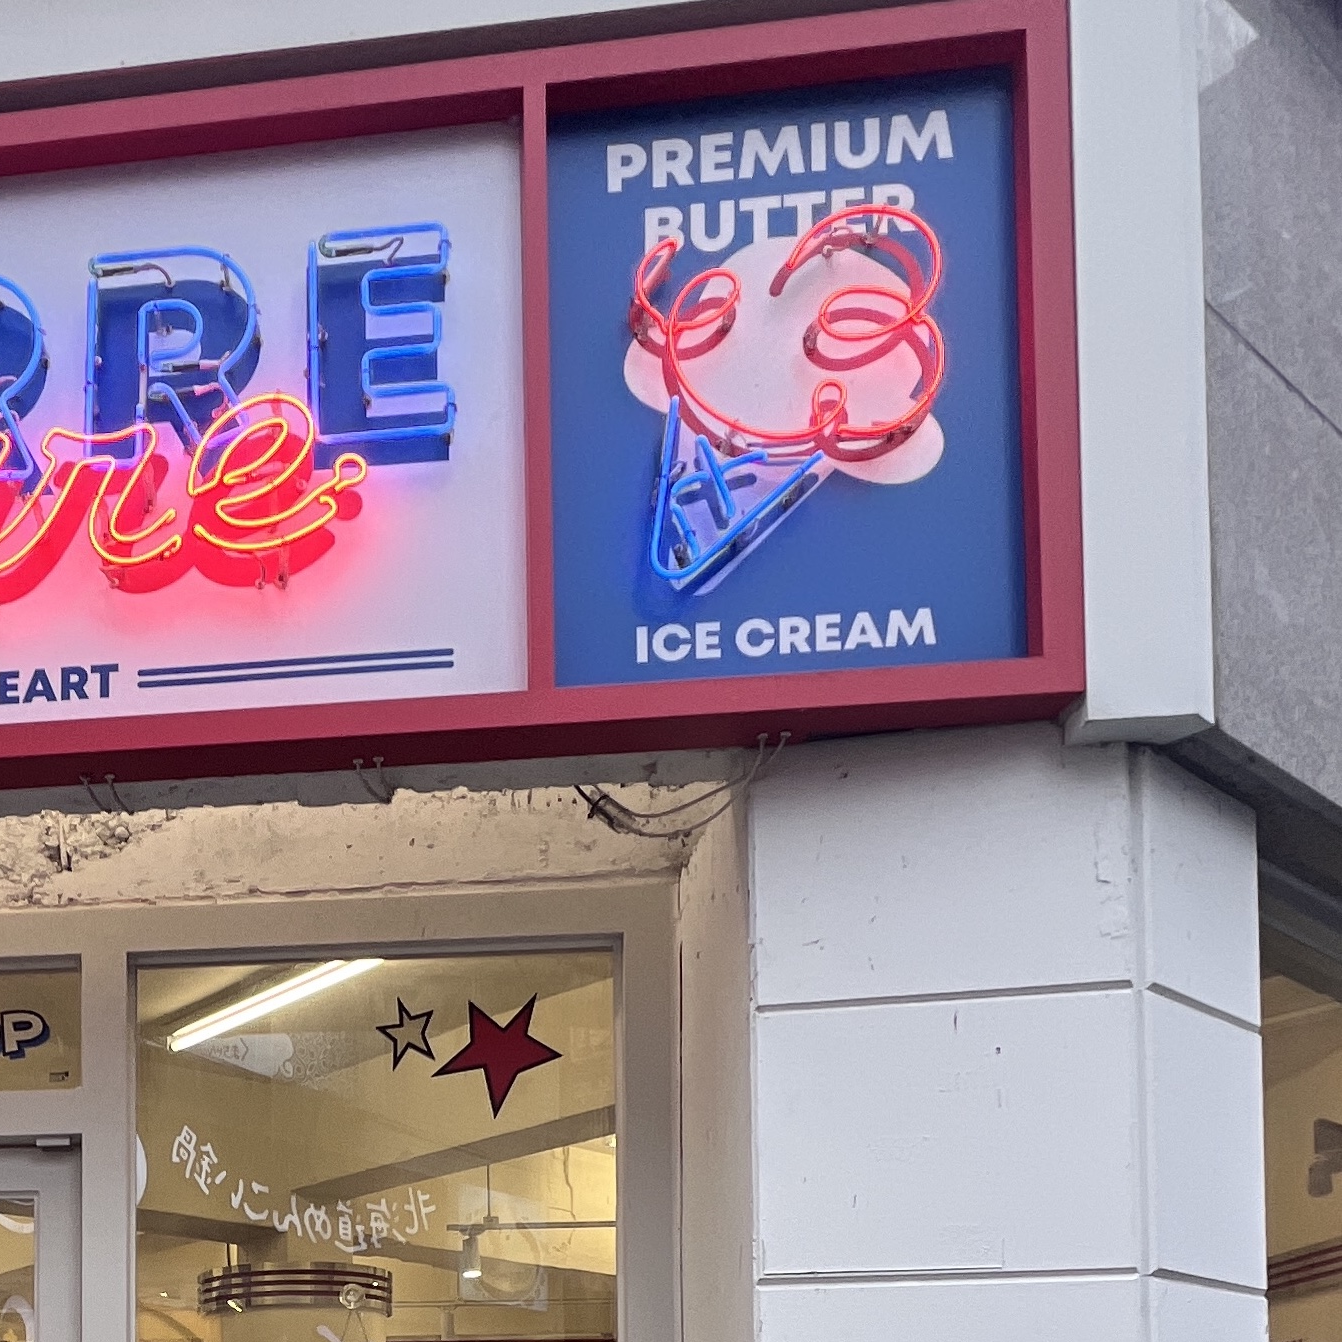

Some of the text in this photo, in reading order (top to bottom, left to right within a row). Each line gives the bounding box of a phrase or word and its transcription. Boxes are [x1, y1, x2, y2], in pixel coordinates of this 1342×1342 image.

[606, 109, 955, 193] PREMIUM
[643, 182, 921, 256] BUTTER
[634, 606, 937, 665] ICE CREAM
